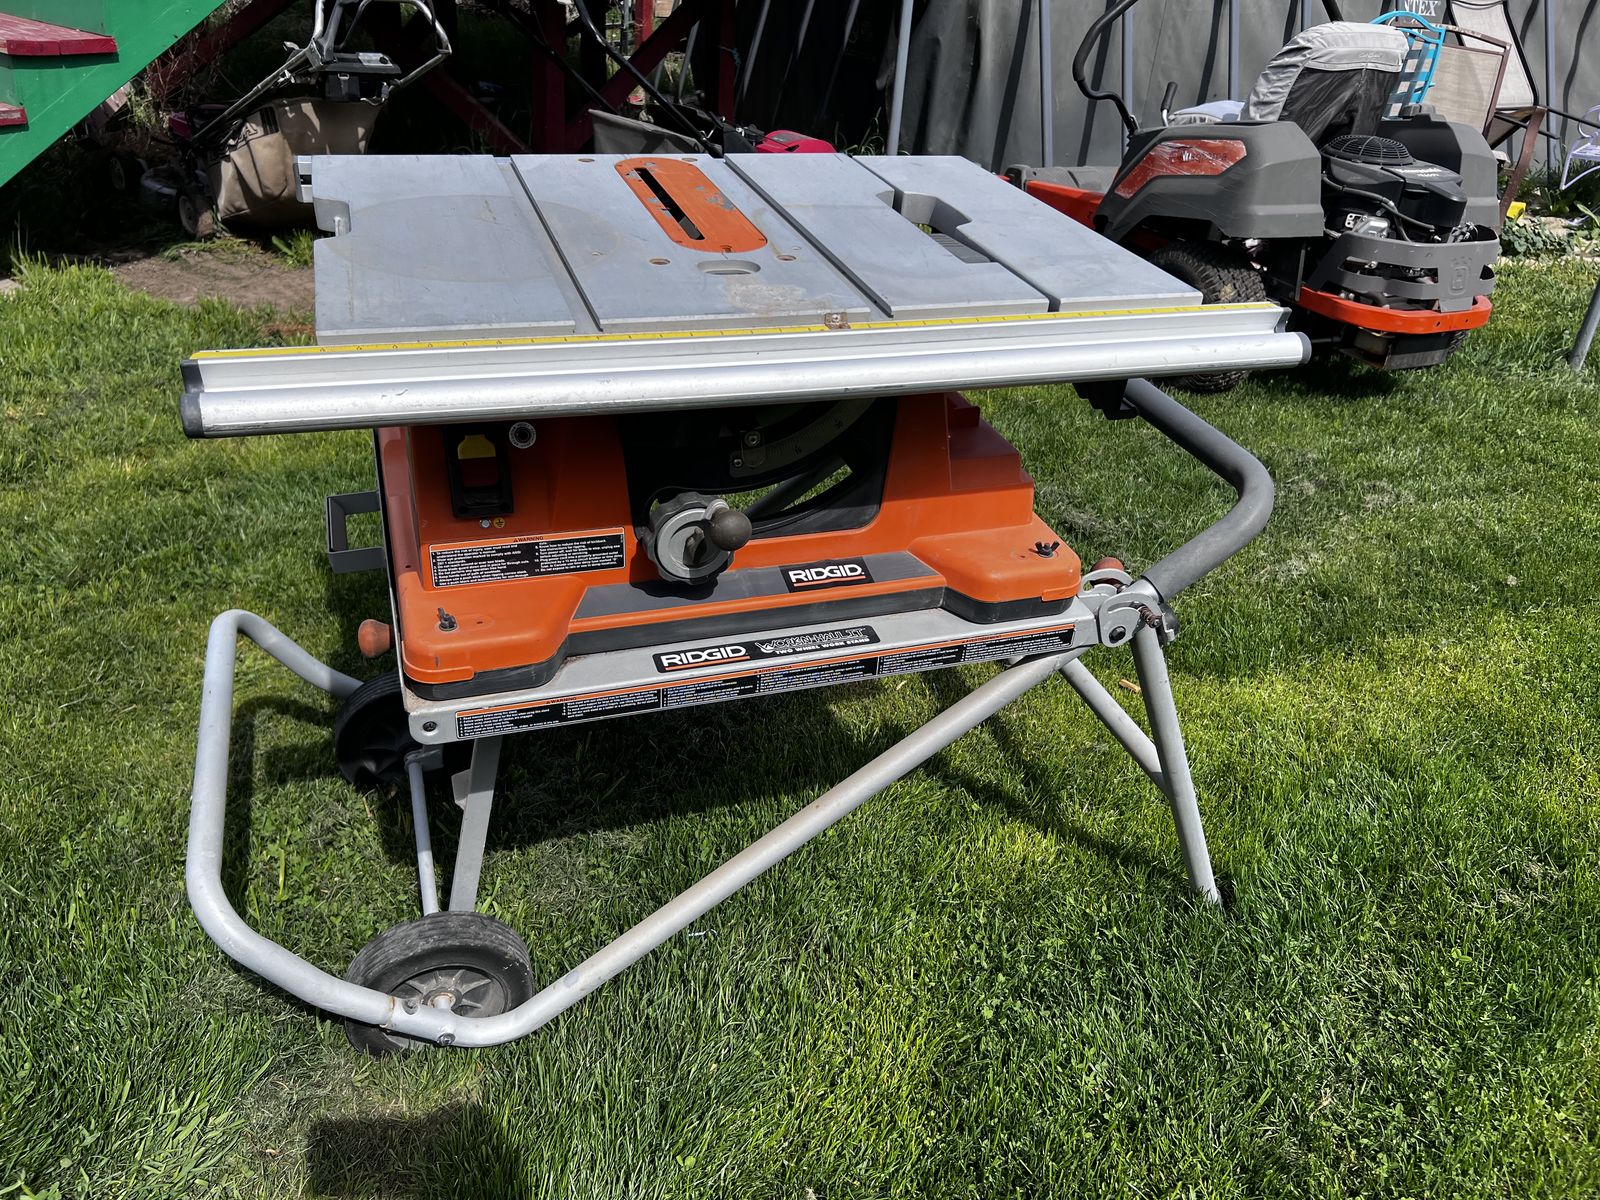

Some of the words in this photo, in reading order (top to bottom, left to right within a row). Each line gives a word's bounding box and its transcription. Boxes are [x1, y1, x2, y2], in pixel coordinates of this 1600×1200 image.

[518, 535, 544, 543] WARNING
[788, 564, 863, 582] RIDGID
[846, 637, 870, 645] STAND
[661, 645, 747, 667] RIDGID
